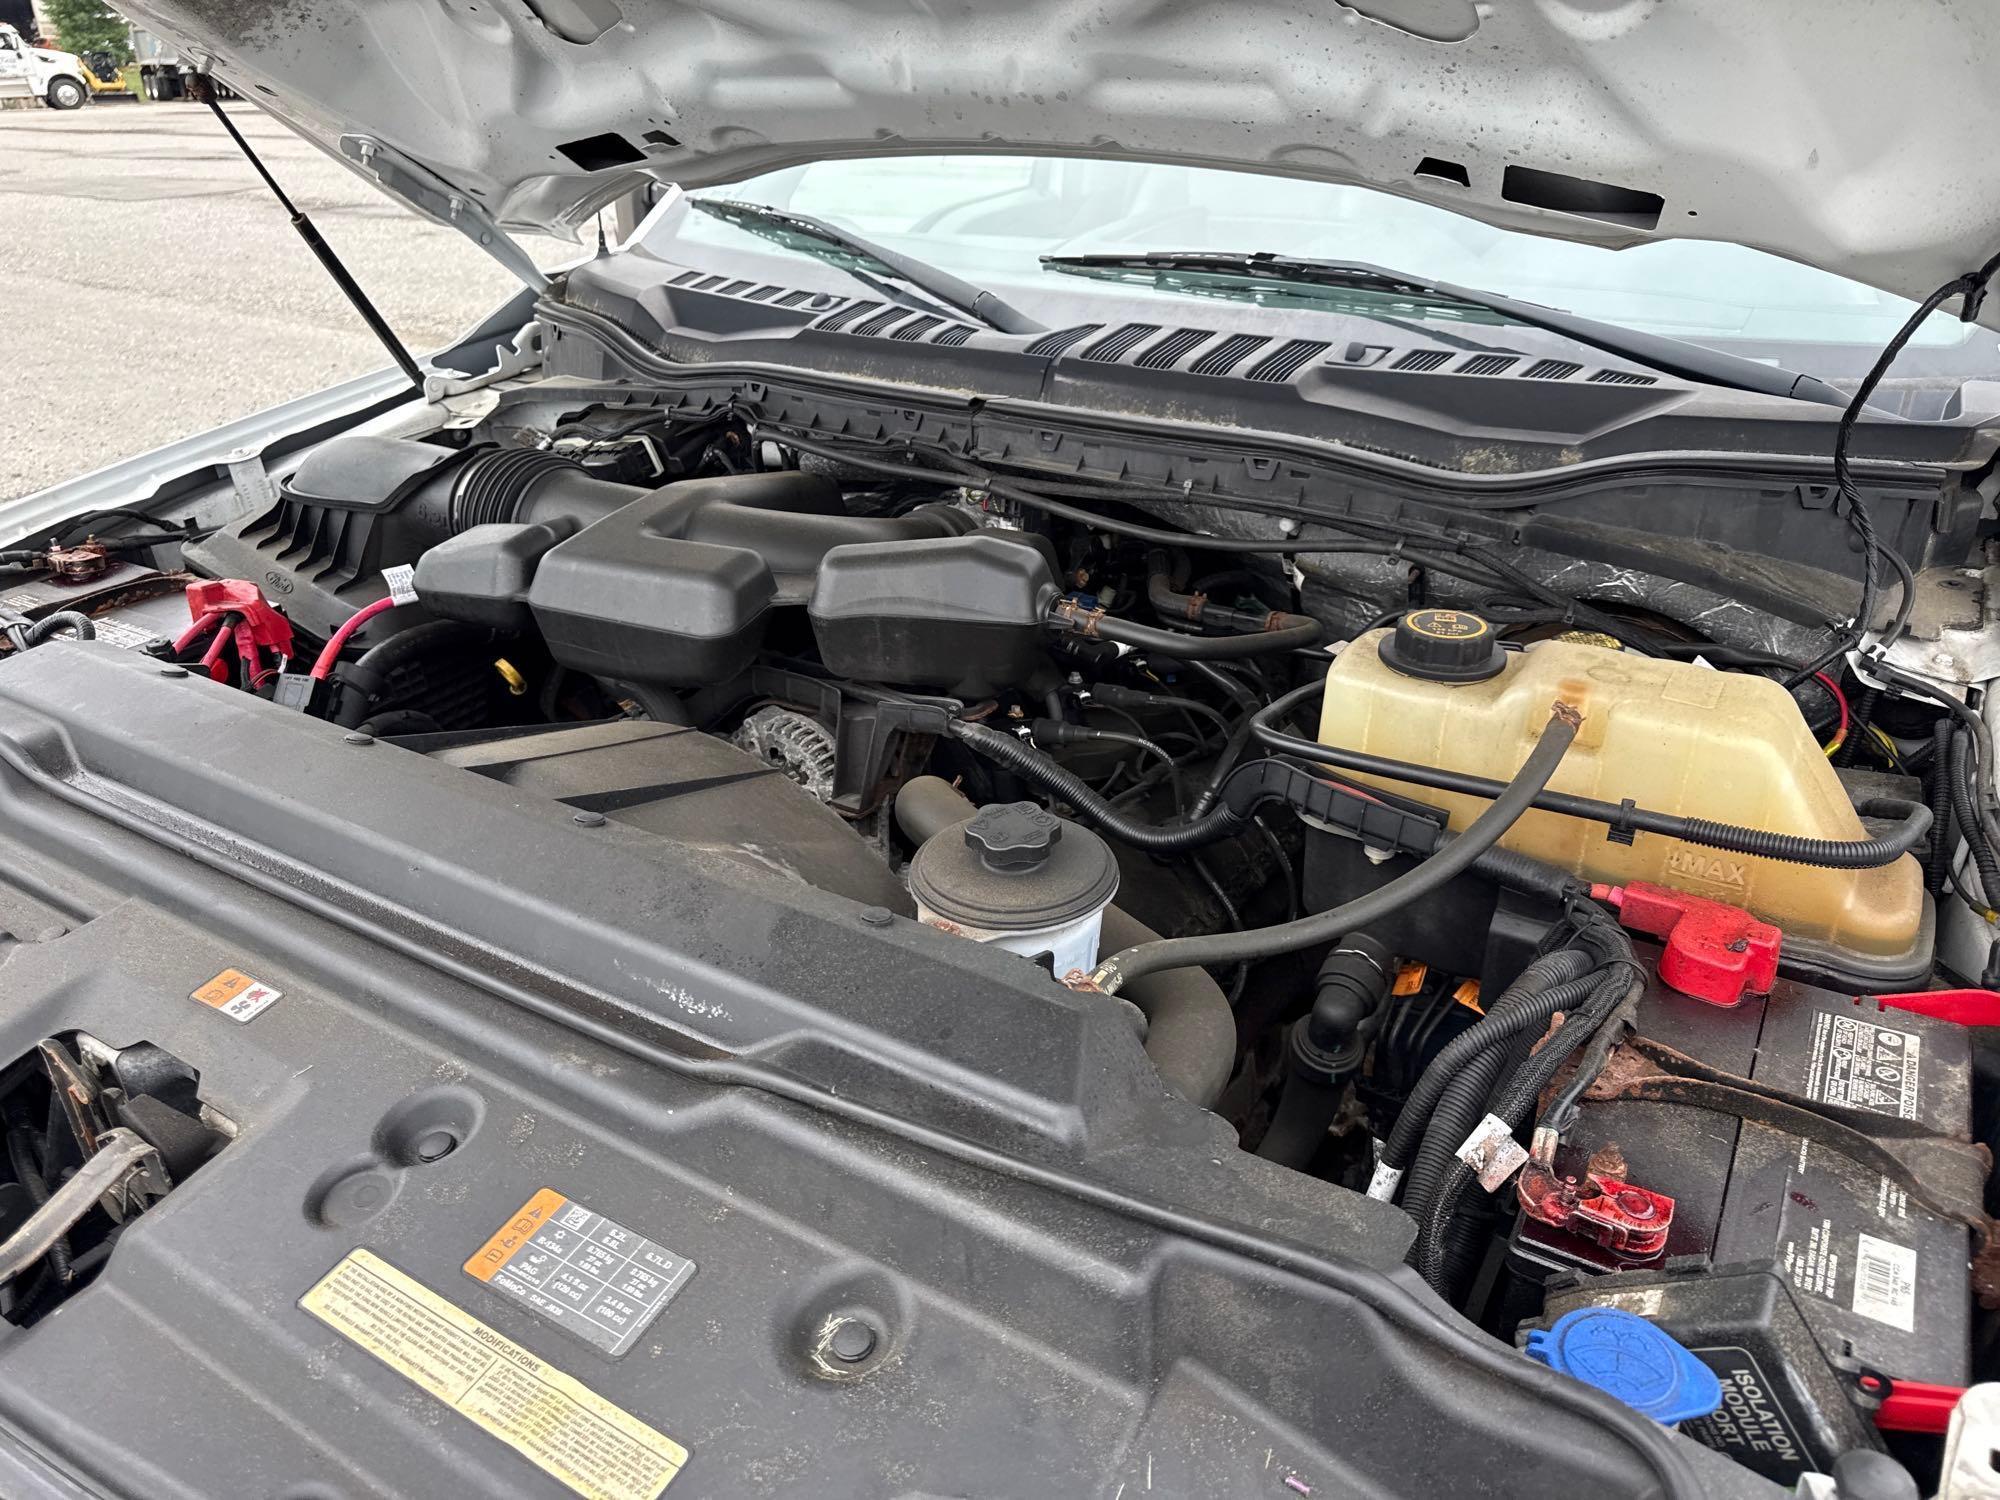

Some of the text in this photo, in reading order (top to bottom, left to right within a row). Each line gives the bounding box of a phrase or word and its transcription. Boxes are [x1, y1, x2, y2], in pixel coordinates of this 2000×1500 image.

[1681, 850, 1744, 886] MAX
[1902, 1060, 1917, 1119] DANGER/POISO
[493, 1273, 528, 1296] FoMoCo
[518, 1261, 539, 1275] PAG
[472, 1326, 541, 1372] MODIFICATIONS
[1719, 1378, 1772, 1451] MODULE
[1731, 1369, 1800, 1461] ISOLATION
